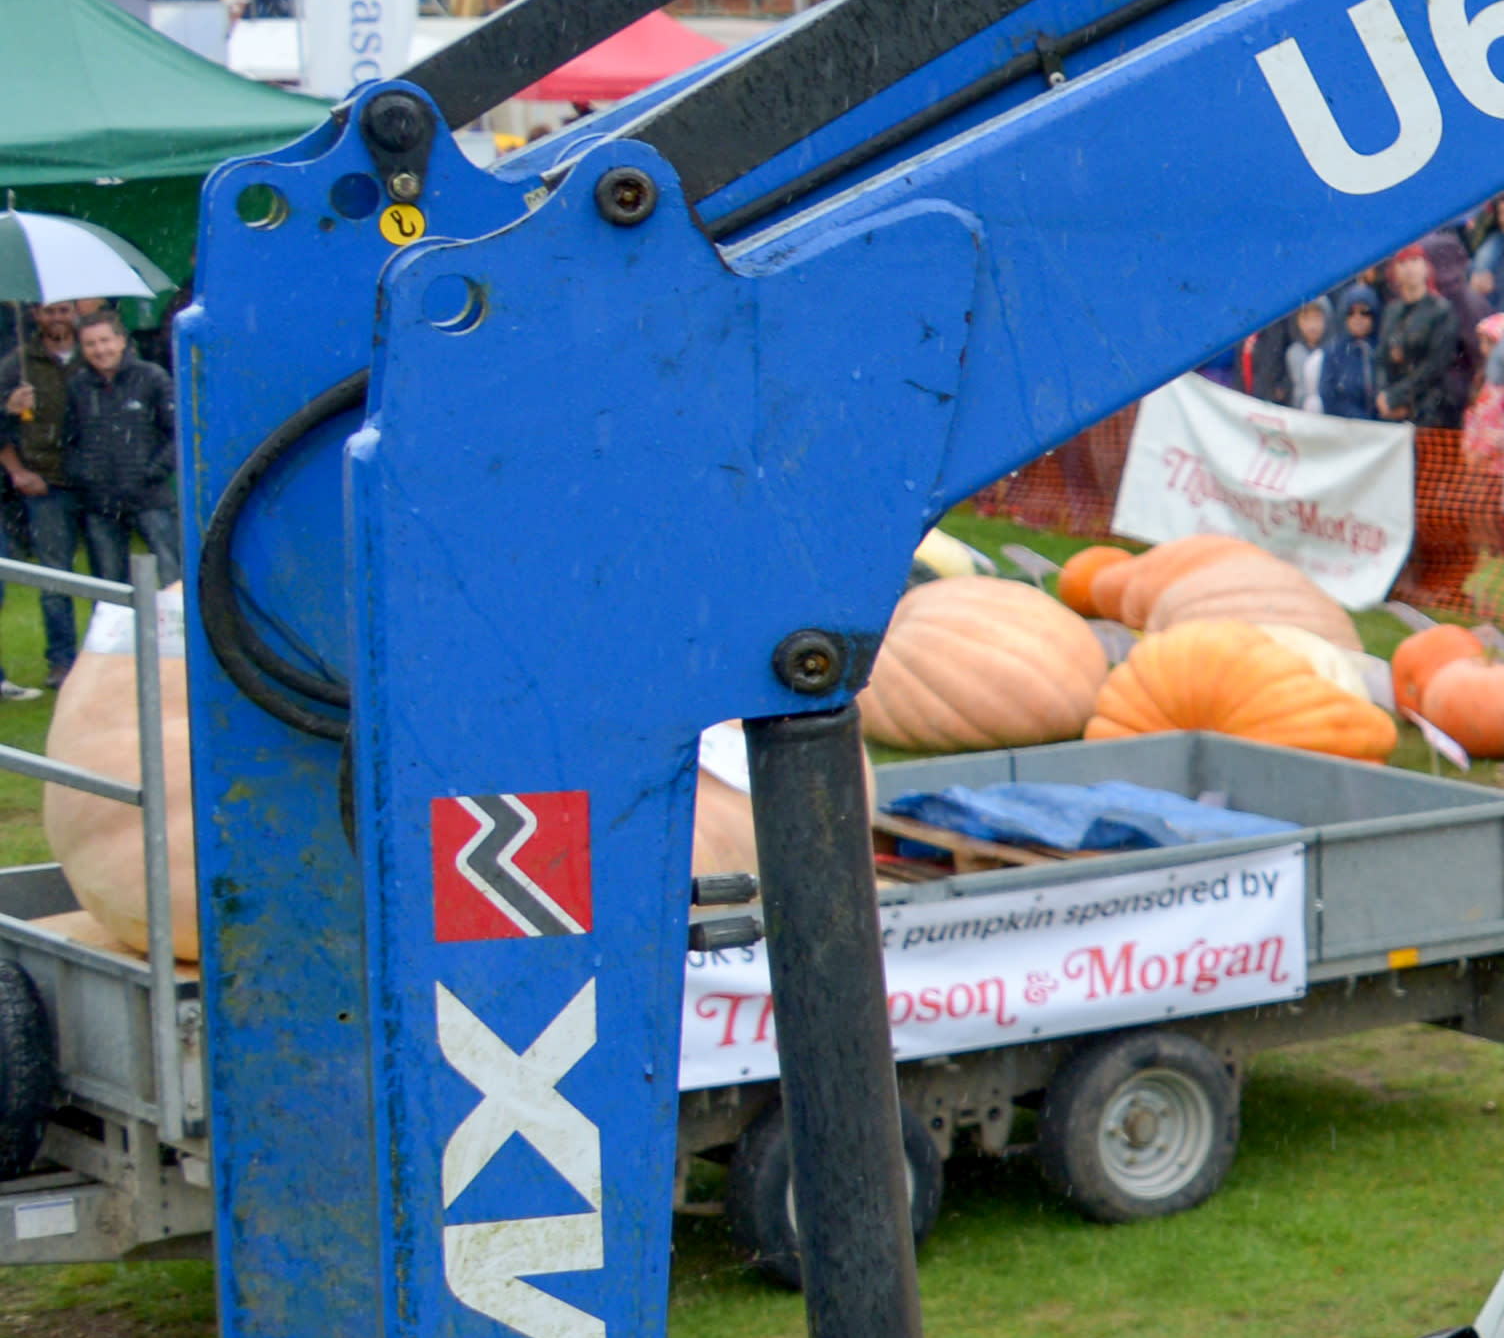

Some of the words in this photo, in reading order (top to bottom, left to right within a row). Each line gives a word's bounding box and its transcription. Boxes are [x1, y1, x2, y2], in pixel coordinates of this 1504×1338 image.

[902, 904, 1056, 949] pumpkin
[1063, 871, 1230, 926] sponsored
[1241, 867, 1281, 900] by
[1024, 970, 1060, 1005] &
[1063, 934, 1289, 999] Morgan
